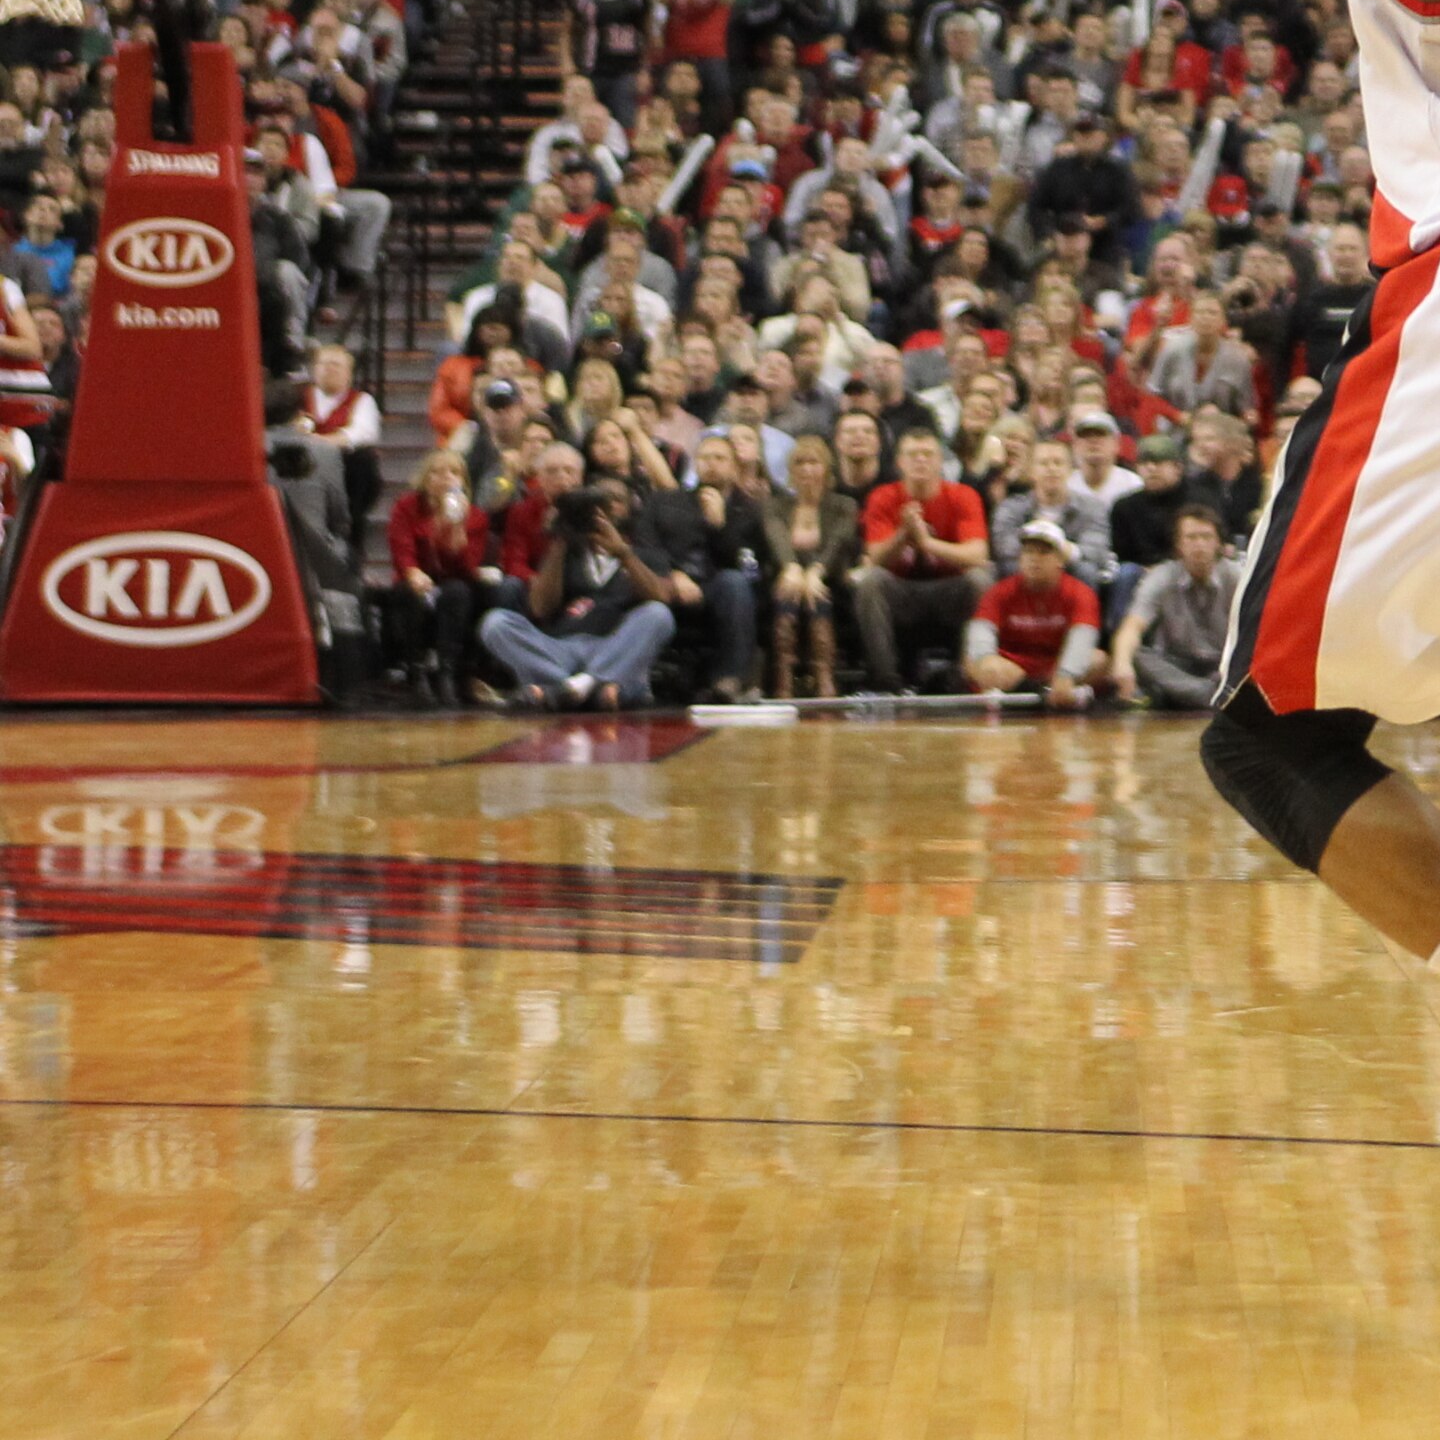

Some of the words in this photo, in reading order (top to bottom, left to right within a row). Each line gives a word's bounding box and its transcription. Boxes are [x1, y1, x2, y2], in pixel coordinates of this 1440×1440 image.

[128, 148, 220, 179] SPALDING
[129, 233, 213, 270] KIA
[116, 301, 220, 329] kia.com
[86, 558, 234, 620] KIA
